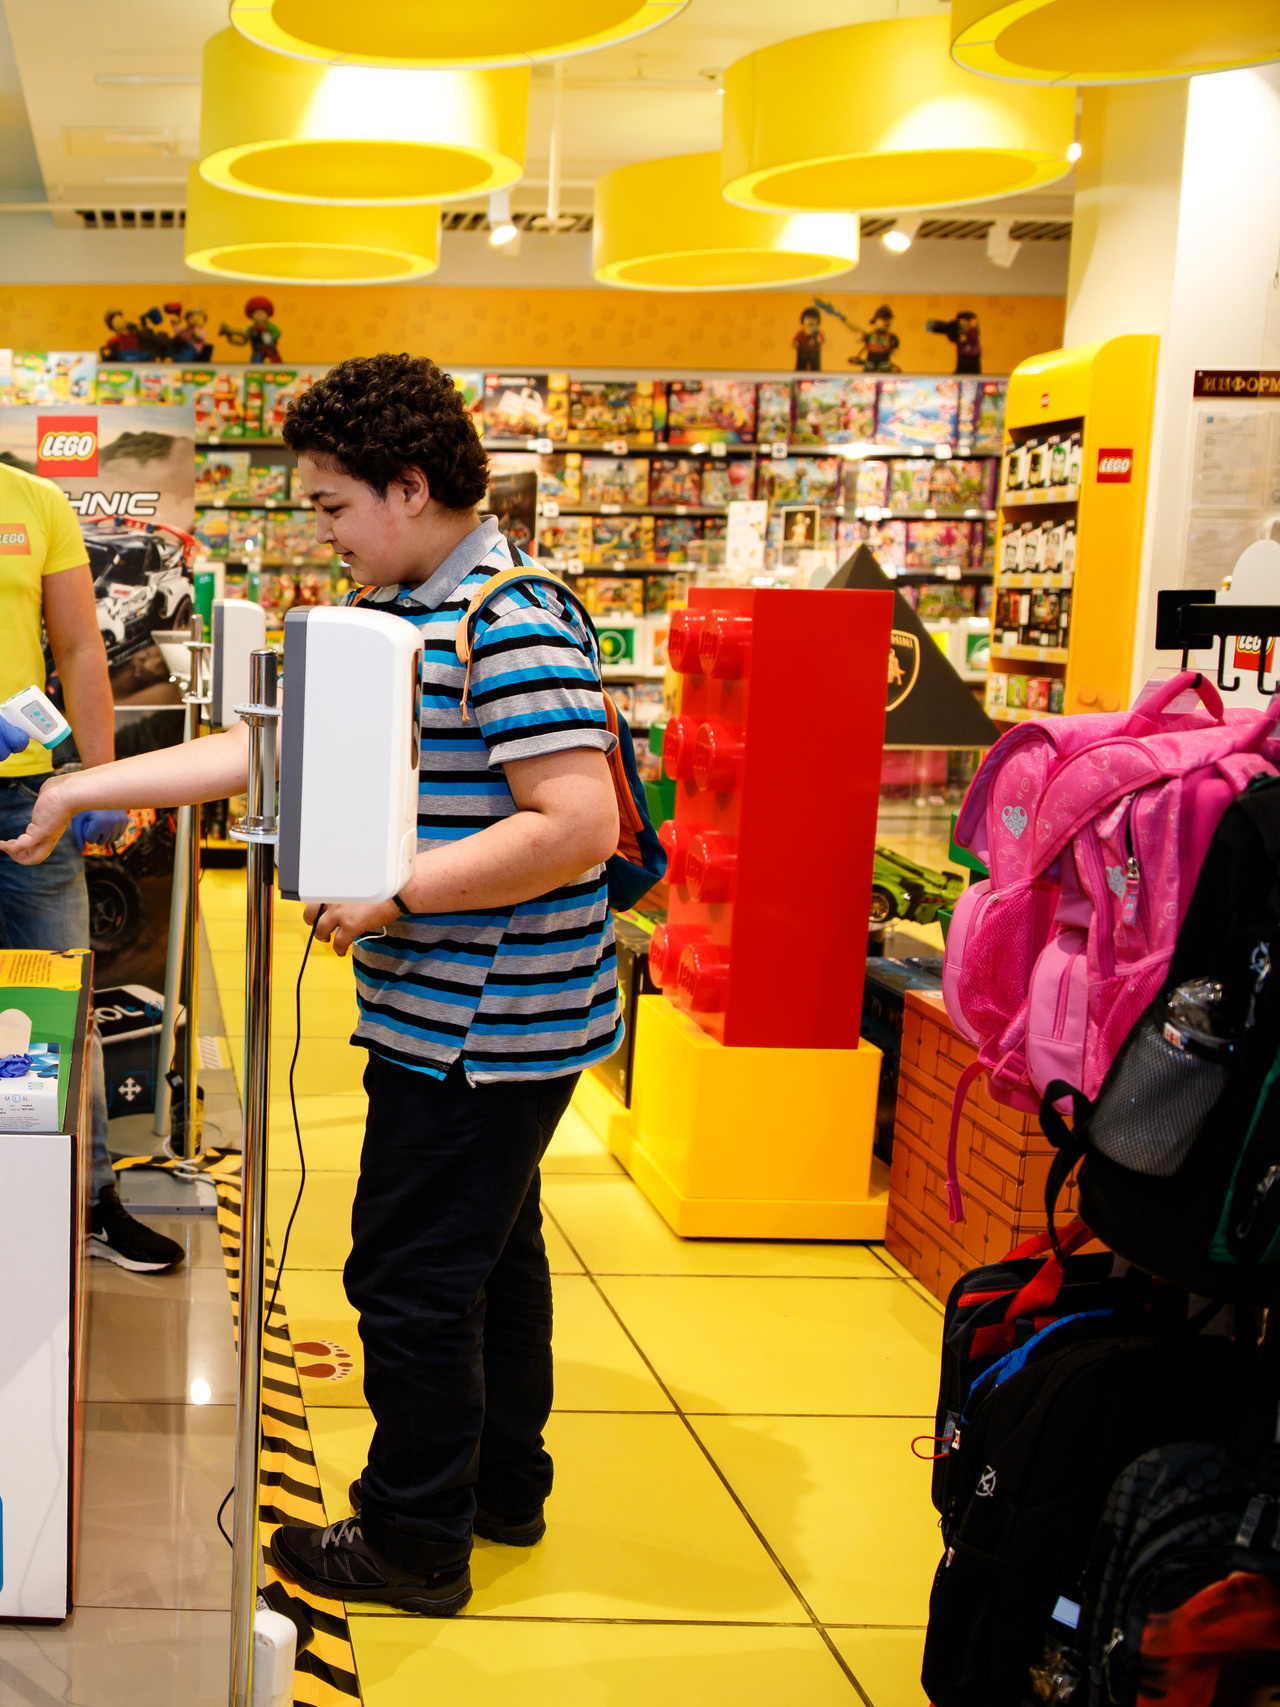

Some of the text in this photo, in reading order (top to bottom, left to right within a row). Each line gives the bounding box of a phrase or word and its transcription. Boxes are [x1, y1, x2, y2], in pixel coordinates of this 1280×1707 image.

[1201, 376, 1280, 392] ИНФОРМ
[40, 433, 95, 459] LEGO
[1099, 457, 1131, 473] LEGO
[64, 491, 160, 516] HNIC
